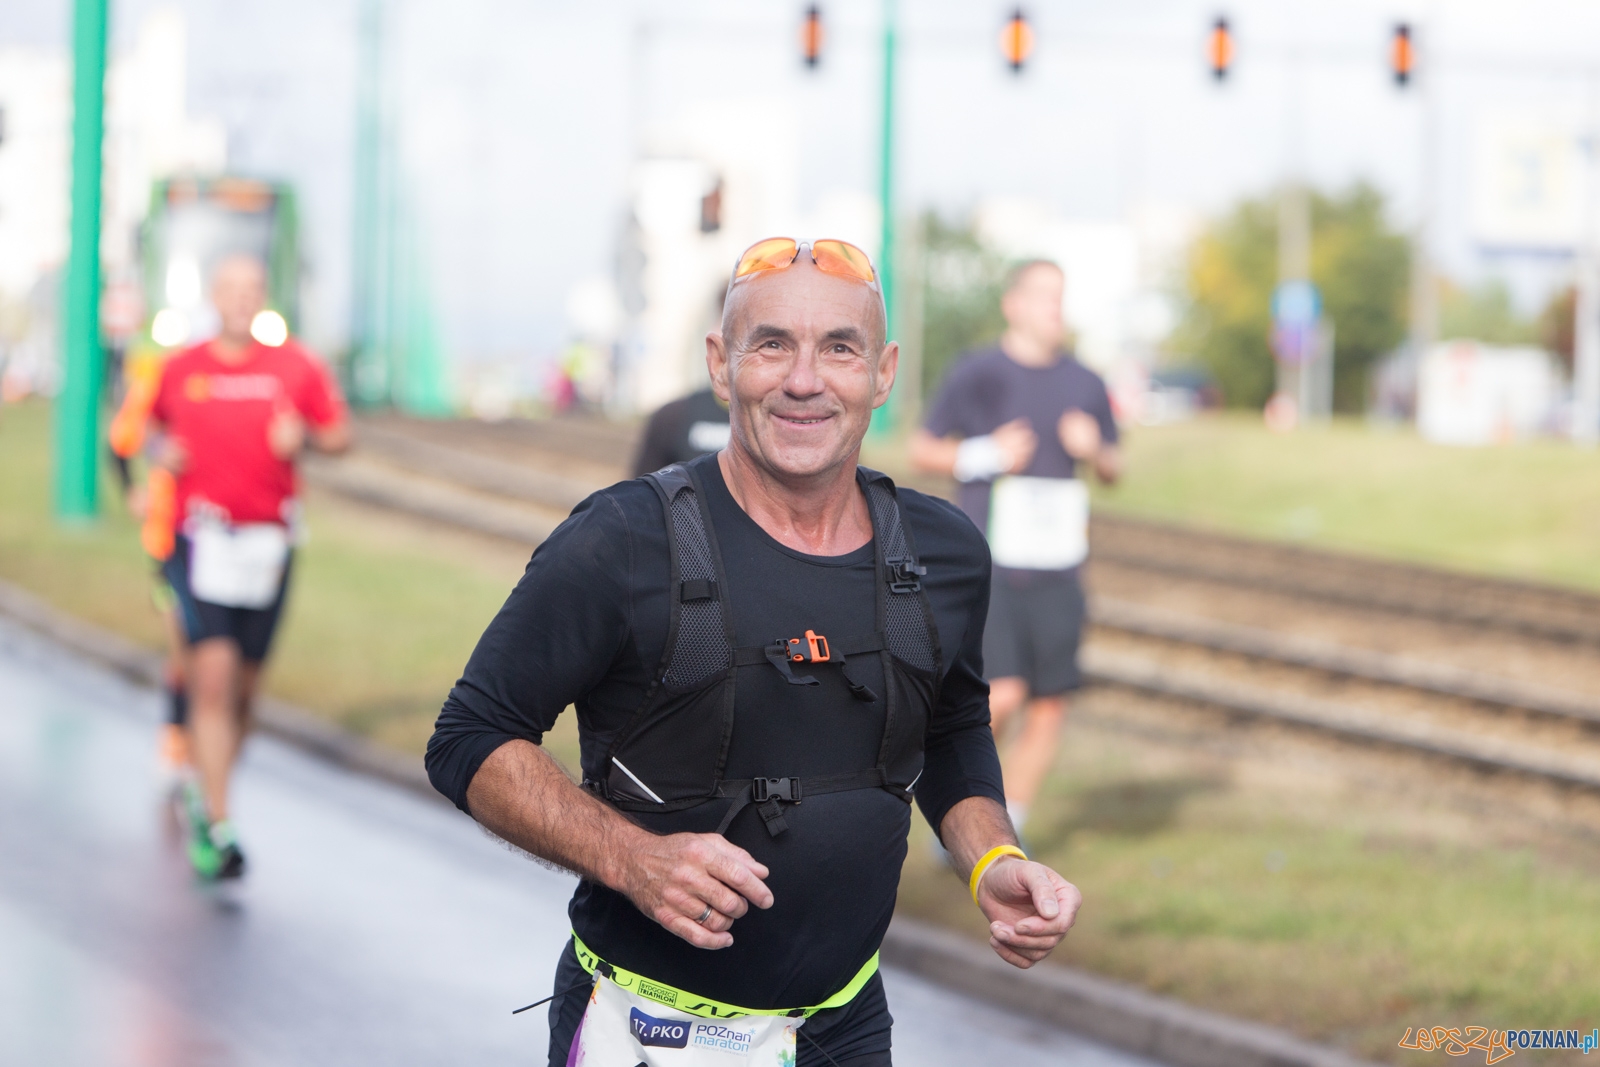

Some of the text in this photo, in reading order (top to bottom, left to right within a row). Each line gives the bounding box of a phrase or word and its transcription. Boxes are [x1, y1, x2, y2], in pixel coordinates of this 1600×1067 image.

[640, 988, 675, 1003] TRIATHLON
[633, 1018, 684, 1039] 17. PKO
[694, 1035, 749, 1052] maraton
